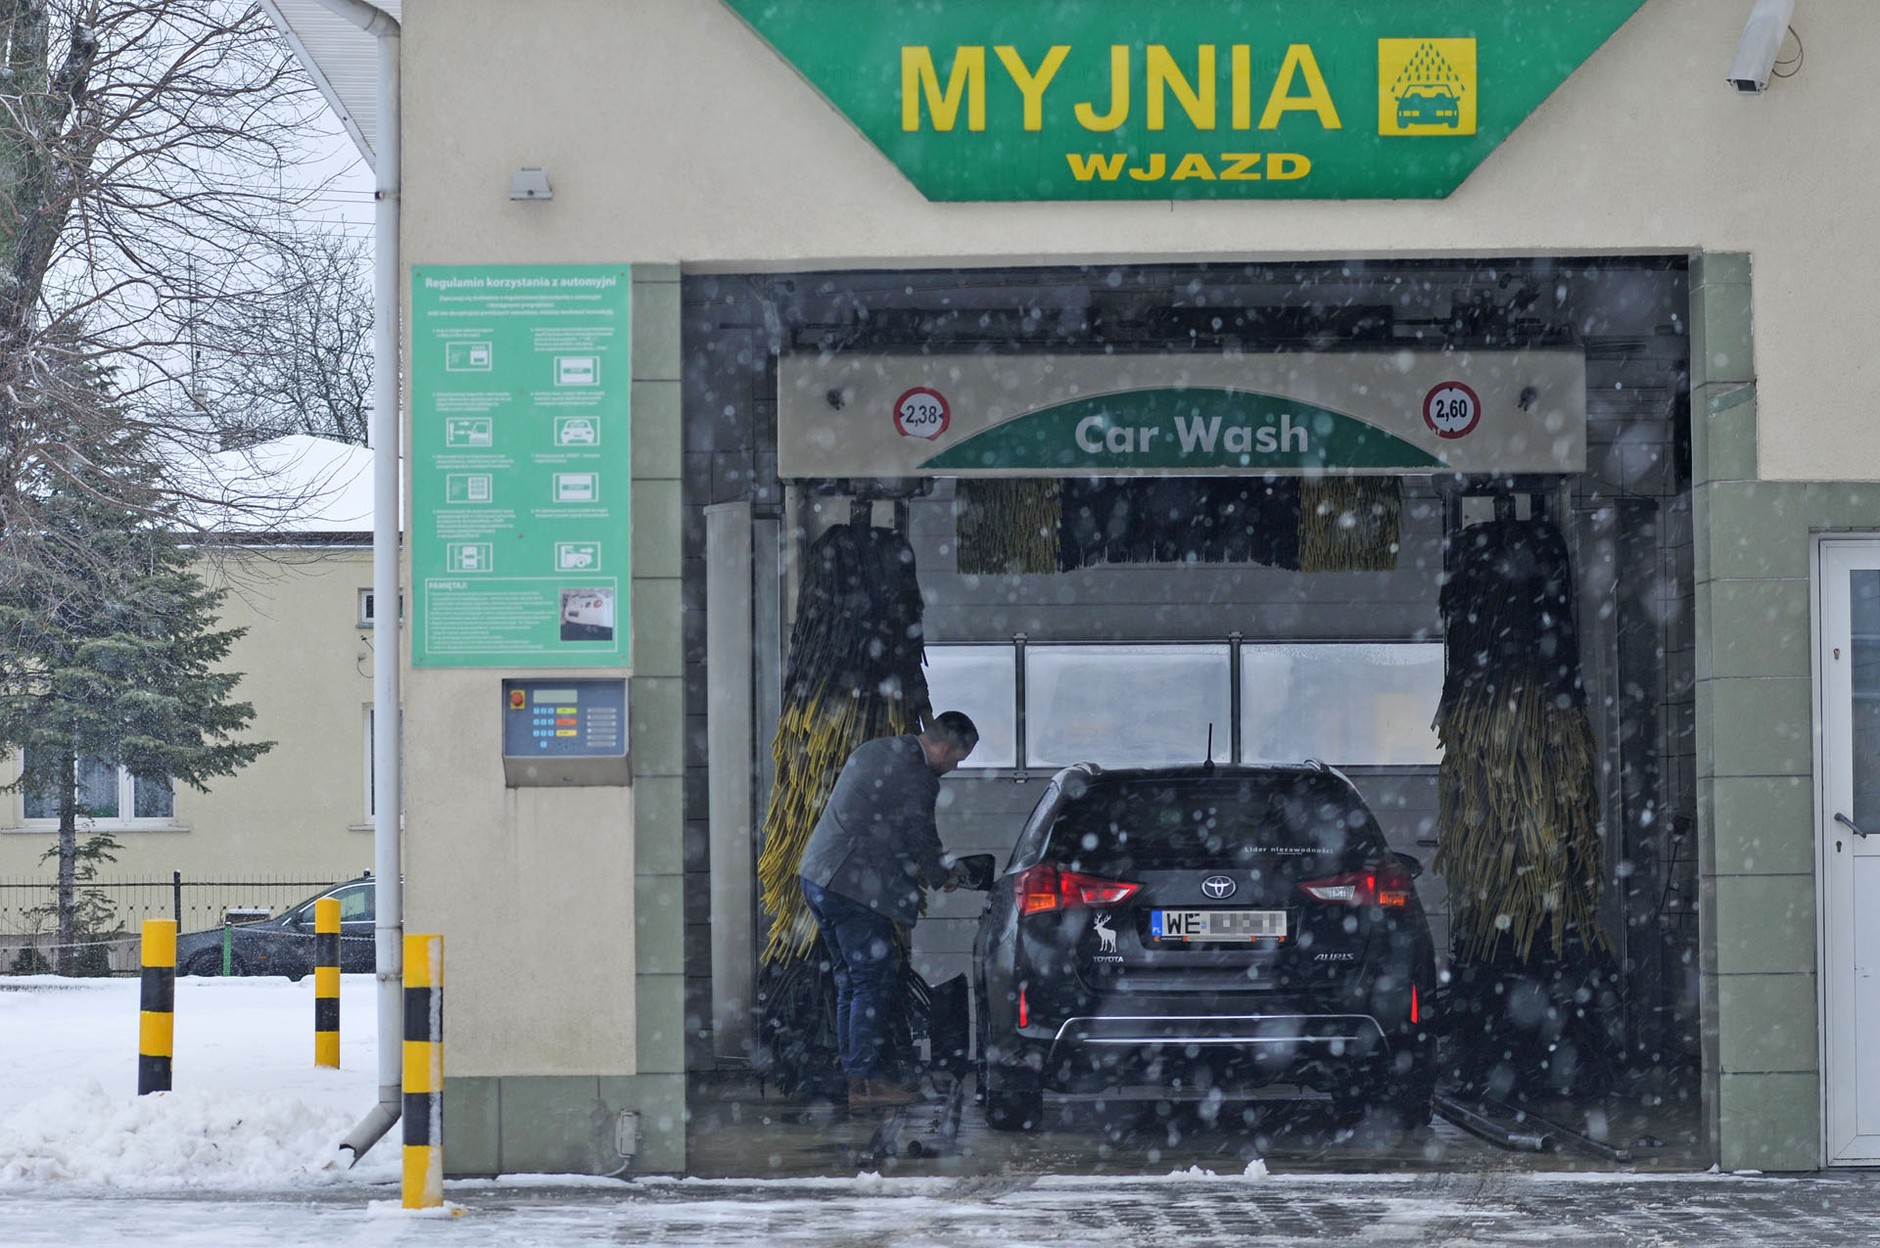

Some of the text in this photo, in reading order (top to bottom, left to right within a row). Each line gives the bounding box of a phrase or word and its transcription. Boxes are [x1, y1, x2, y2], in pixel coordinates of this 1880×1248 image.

[901, 44, 1342, 132] MYJNIA
[1066, 153, 1311, 181] WJAZD
[425, 275, 616, 290] Regulamin korzystania z automyjni
[905, 404, 937, 427] 2,38
[1436, 399, 1468, 422] 2,60
[1075, 414, 1308, 453] Car Wash
[1166, 912, 1201, 935] WE
